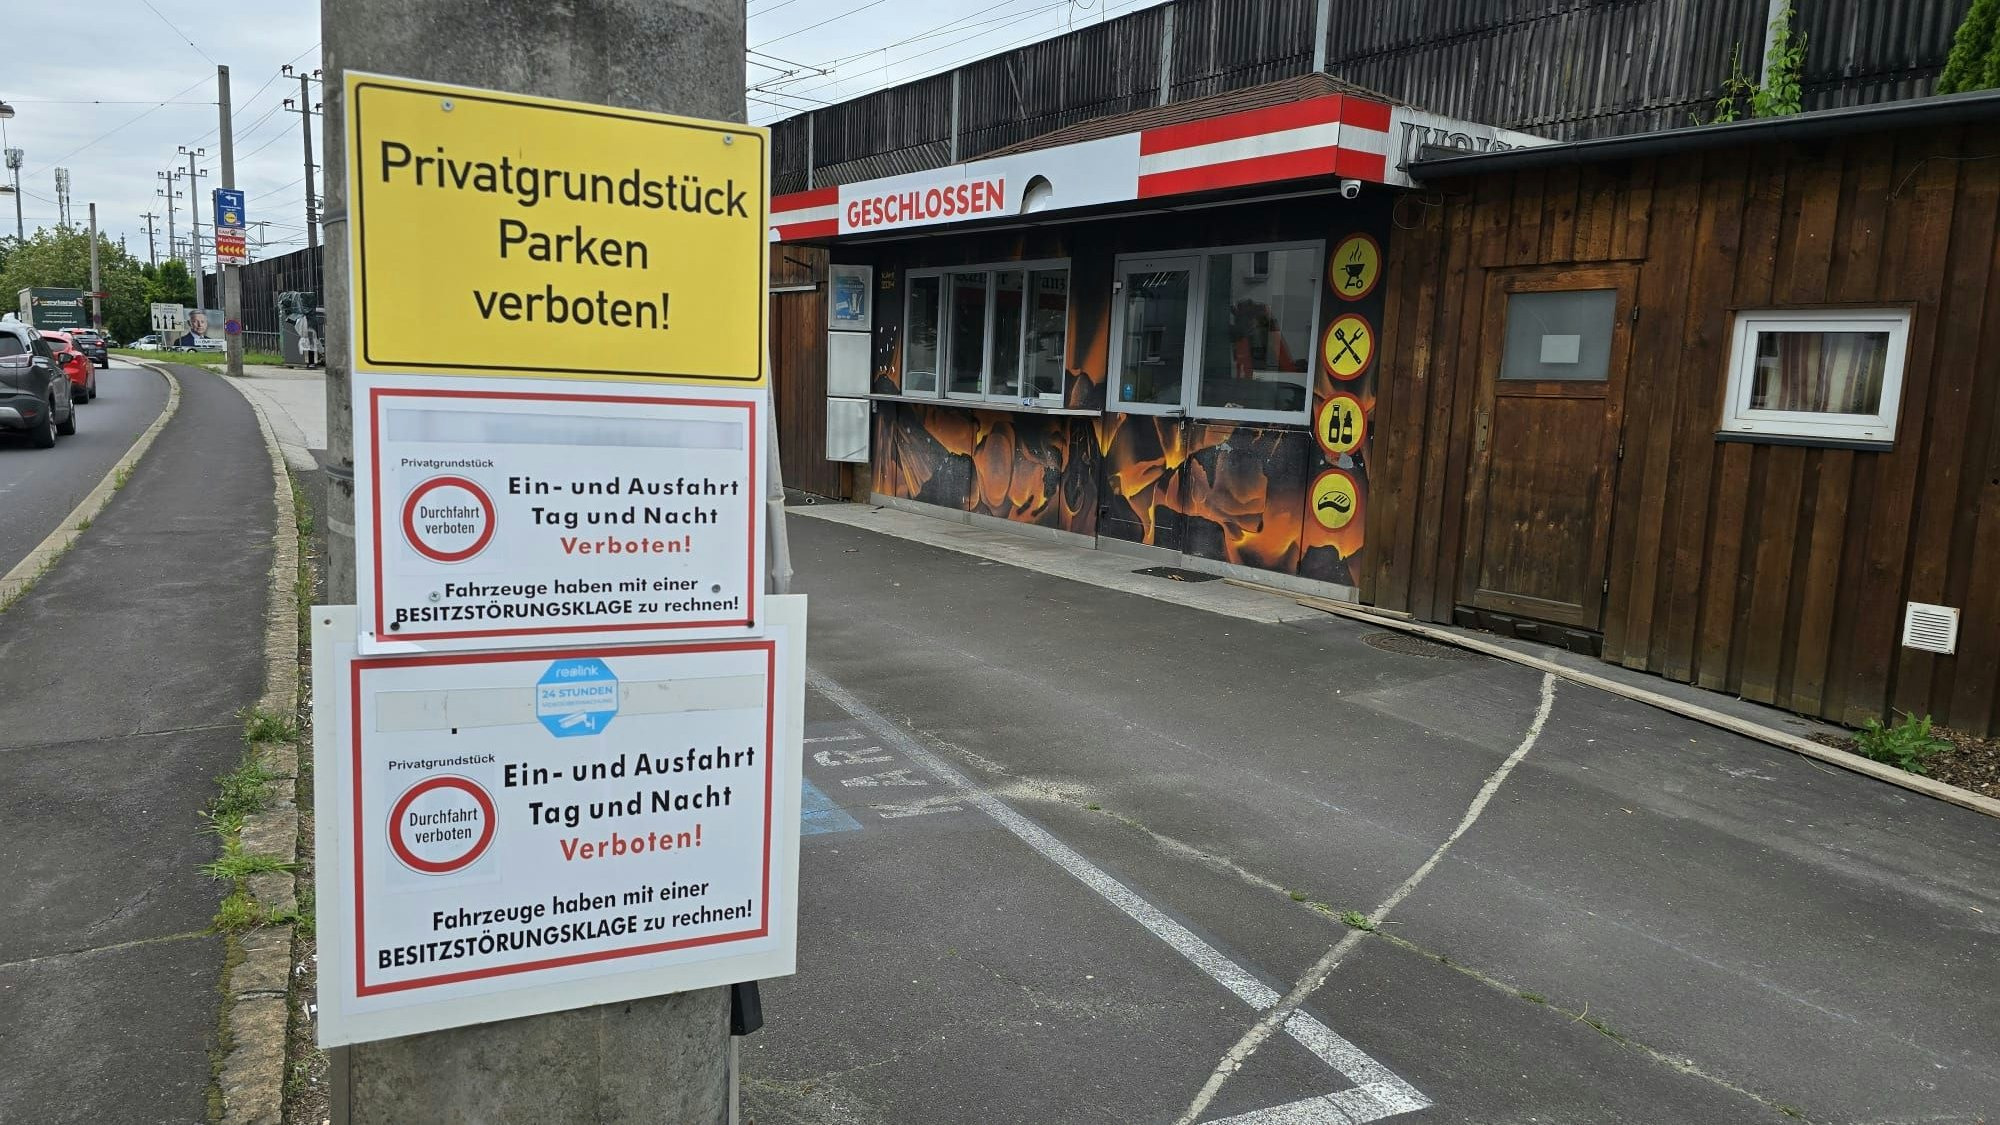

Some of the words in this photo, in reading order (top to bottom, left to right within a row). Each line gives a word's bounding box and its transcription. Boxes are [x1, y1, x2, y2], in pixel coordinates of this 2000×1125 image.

[381, 141, 748, 218] Privatgrundstück
[847, 179, 1004, 228] GESCHLOSSEN
[500, 219, 647, 269] Parken
[473, 284, 668, 329] verboten!
[401, 458, 493, 469] Privatgrundstück
[509, 477, 562, 494] Ein-
[572, 477, 619, 494] und
[628, 478, 738, 495] Ausfahrt
[420, 505, 480, 519] Durchfahrt
[532, 508, 577, 529] Tag
[588, 506, 634, 524] und
[645, 507, 717, 524] Nacht
[425, 521, 474, 534] verboten
[561, 535, 691, 556] Verboten!
[446, 582, 547, 598] Fahrzeuge
[555, 579, 612, 594] haben
[620, 578, 647, 591] mit
[653, 577, 698, 591] einer
[396, 599, 632, 622] BESITZSTÖRUNGSKLAGE
[639, 603, 657, 613] zu
[665, 596, 738, 612] rechnen!
[542, 689, 556, 698] 24
[559, 686, 613, 698] STUNDEN
[389, 754, 495, 770] Privatgrundstück
[505, 763, 562, 787] Ein-
[573, 754, 625, 781] und
[635, 746, 754, 776] Ausfahrt
[410, 808, 477, 826] Durchfahrt
[529, 802, 579, 827] Tag
[590, 792, 641, 819] und
[652, 785, 731, 813] Nacht
[416, 827, 471, 843] verboten
[560, 824, 702, 861] Verboten!
[434, 904, 545, 931] Fahrzeuge
[553, 893, 615, 915] haben
[624, 885, 653, 905] mit
[660, 881, 709, 900] einer
[379, 915, 638, 968] BESITZSTÖRUNGSKLAGE
[644, 917, 665, 931] zu
[673, 899, 751, 927] rechnen!
